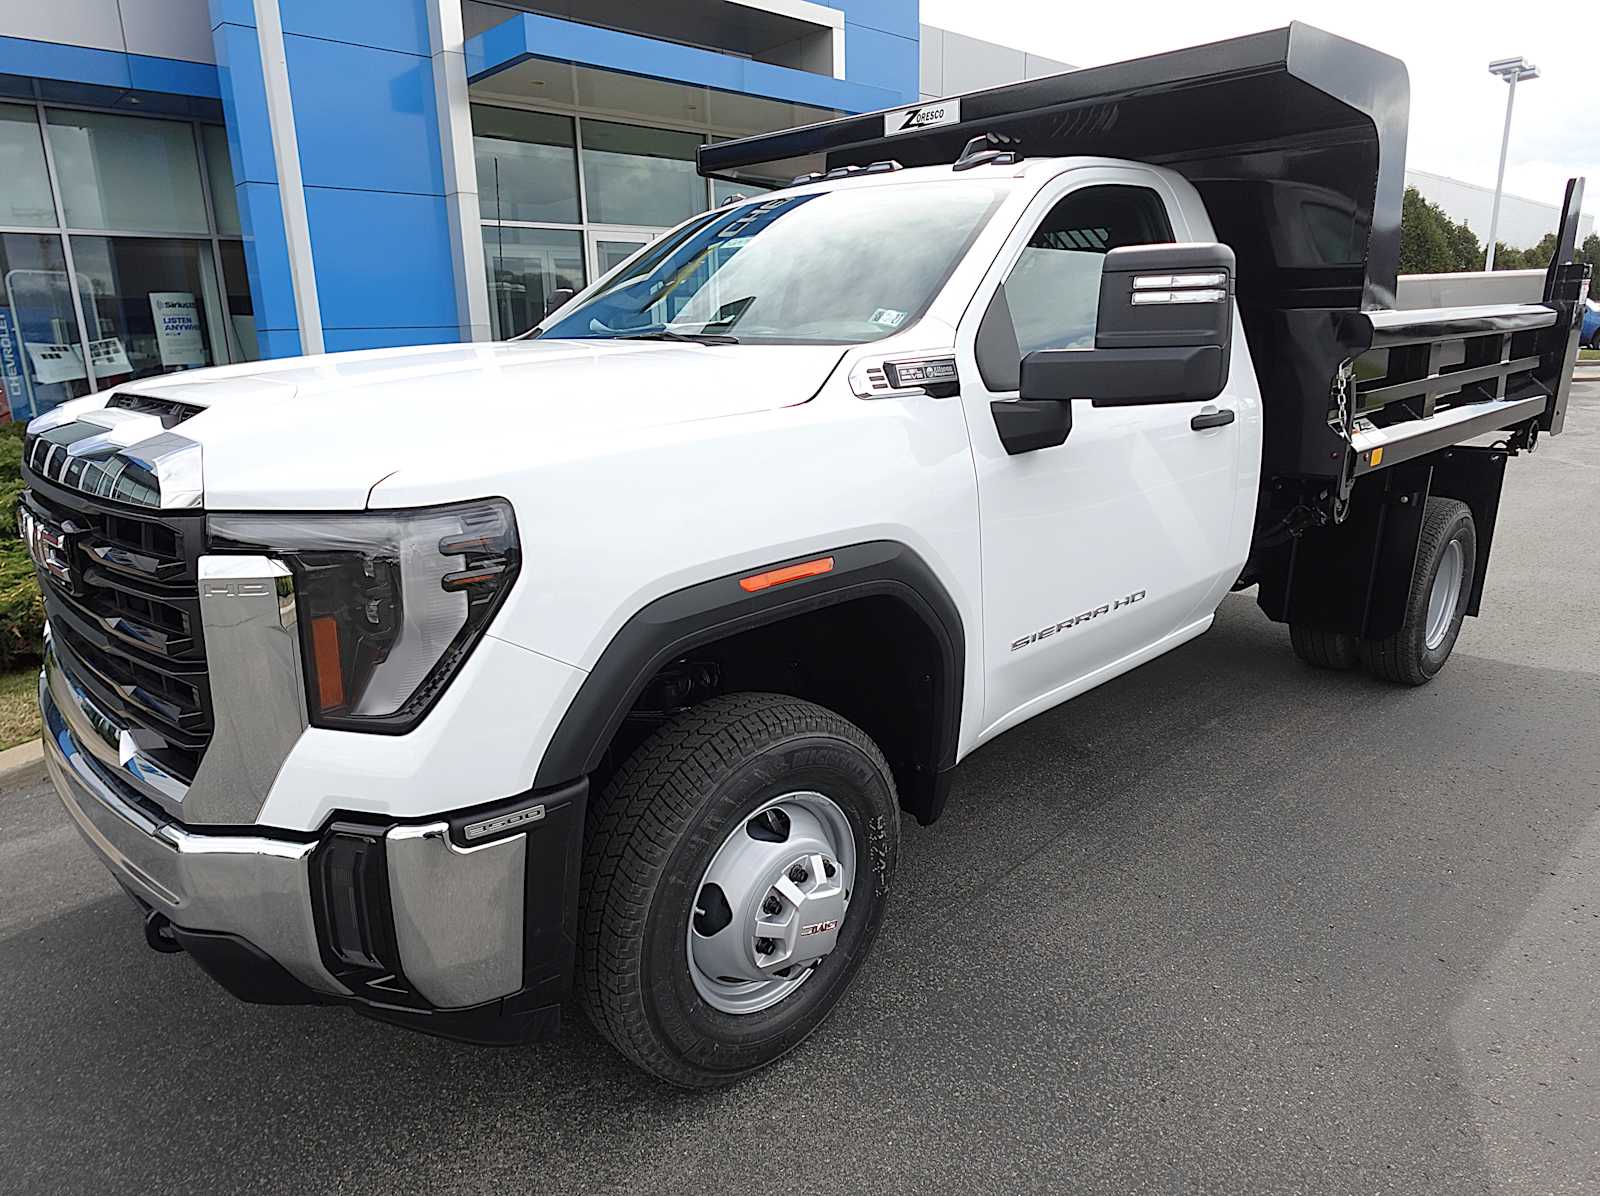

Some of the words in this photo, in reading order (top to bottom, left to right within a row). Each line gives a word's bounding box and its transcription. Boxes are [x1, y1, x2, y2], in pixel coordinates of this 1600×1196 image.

[898, 108, 945, 131] ZORESCO
[1010, 603, 1110, 652] SIERRA
[1113, 589, 1147, 611] HD
[800, 920, 839, 937] GMC
